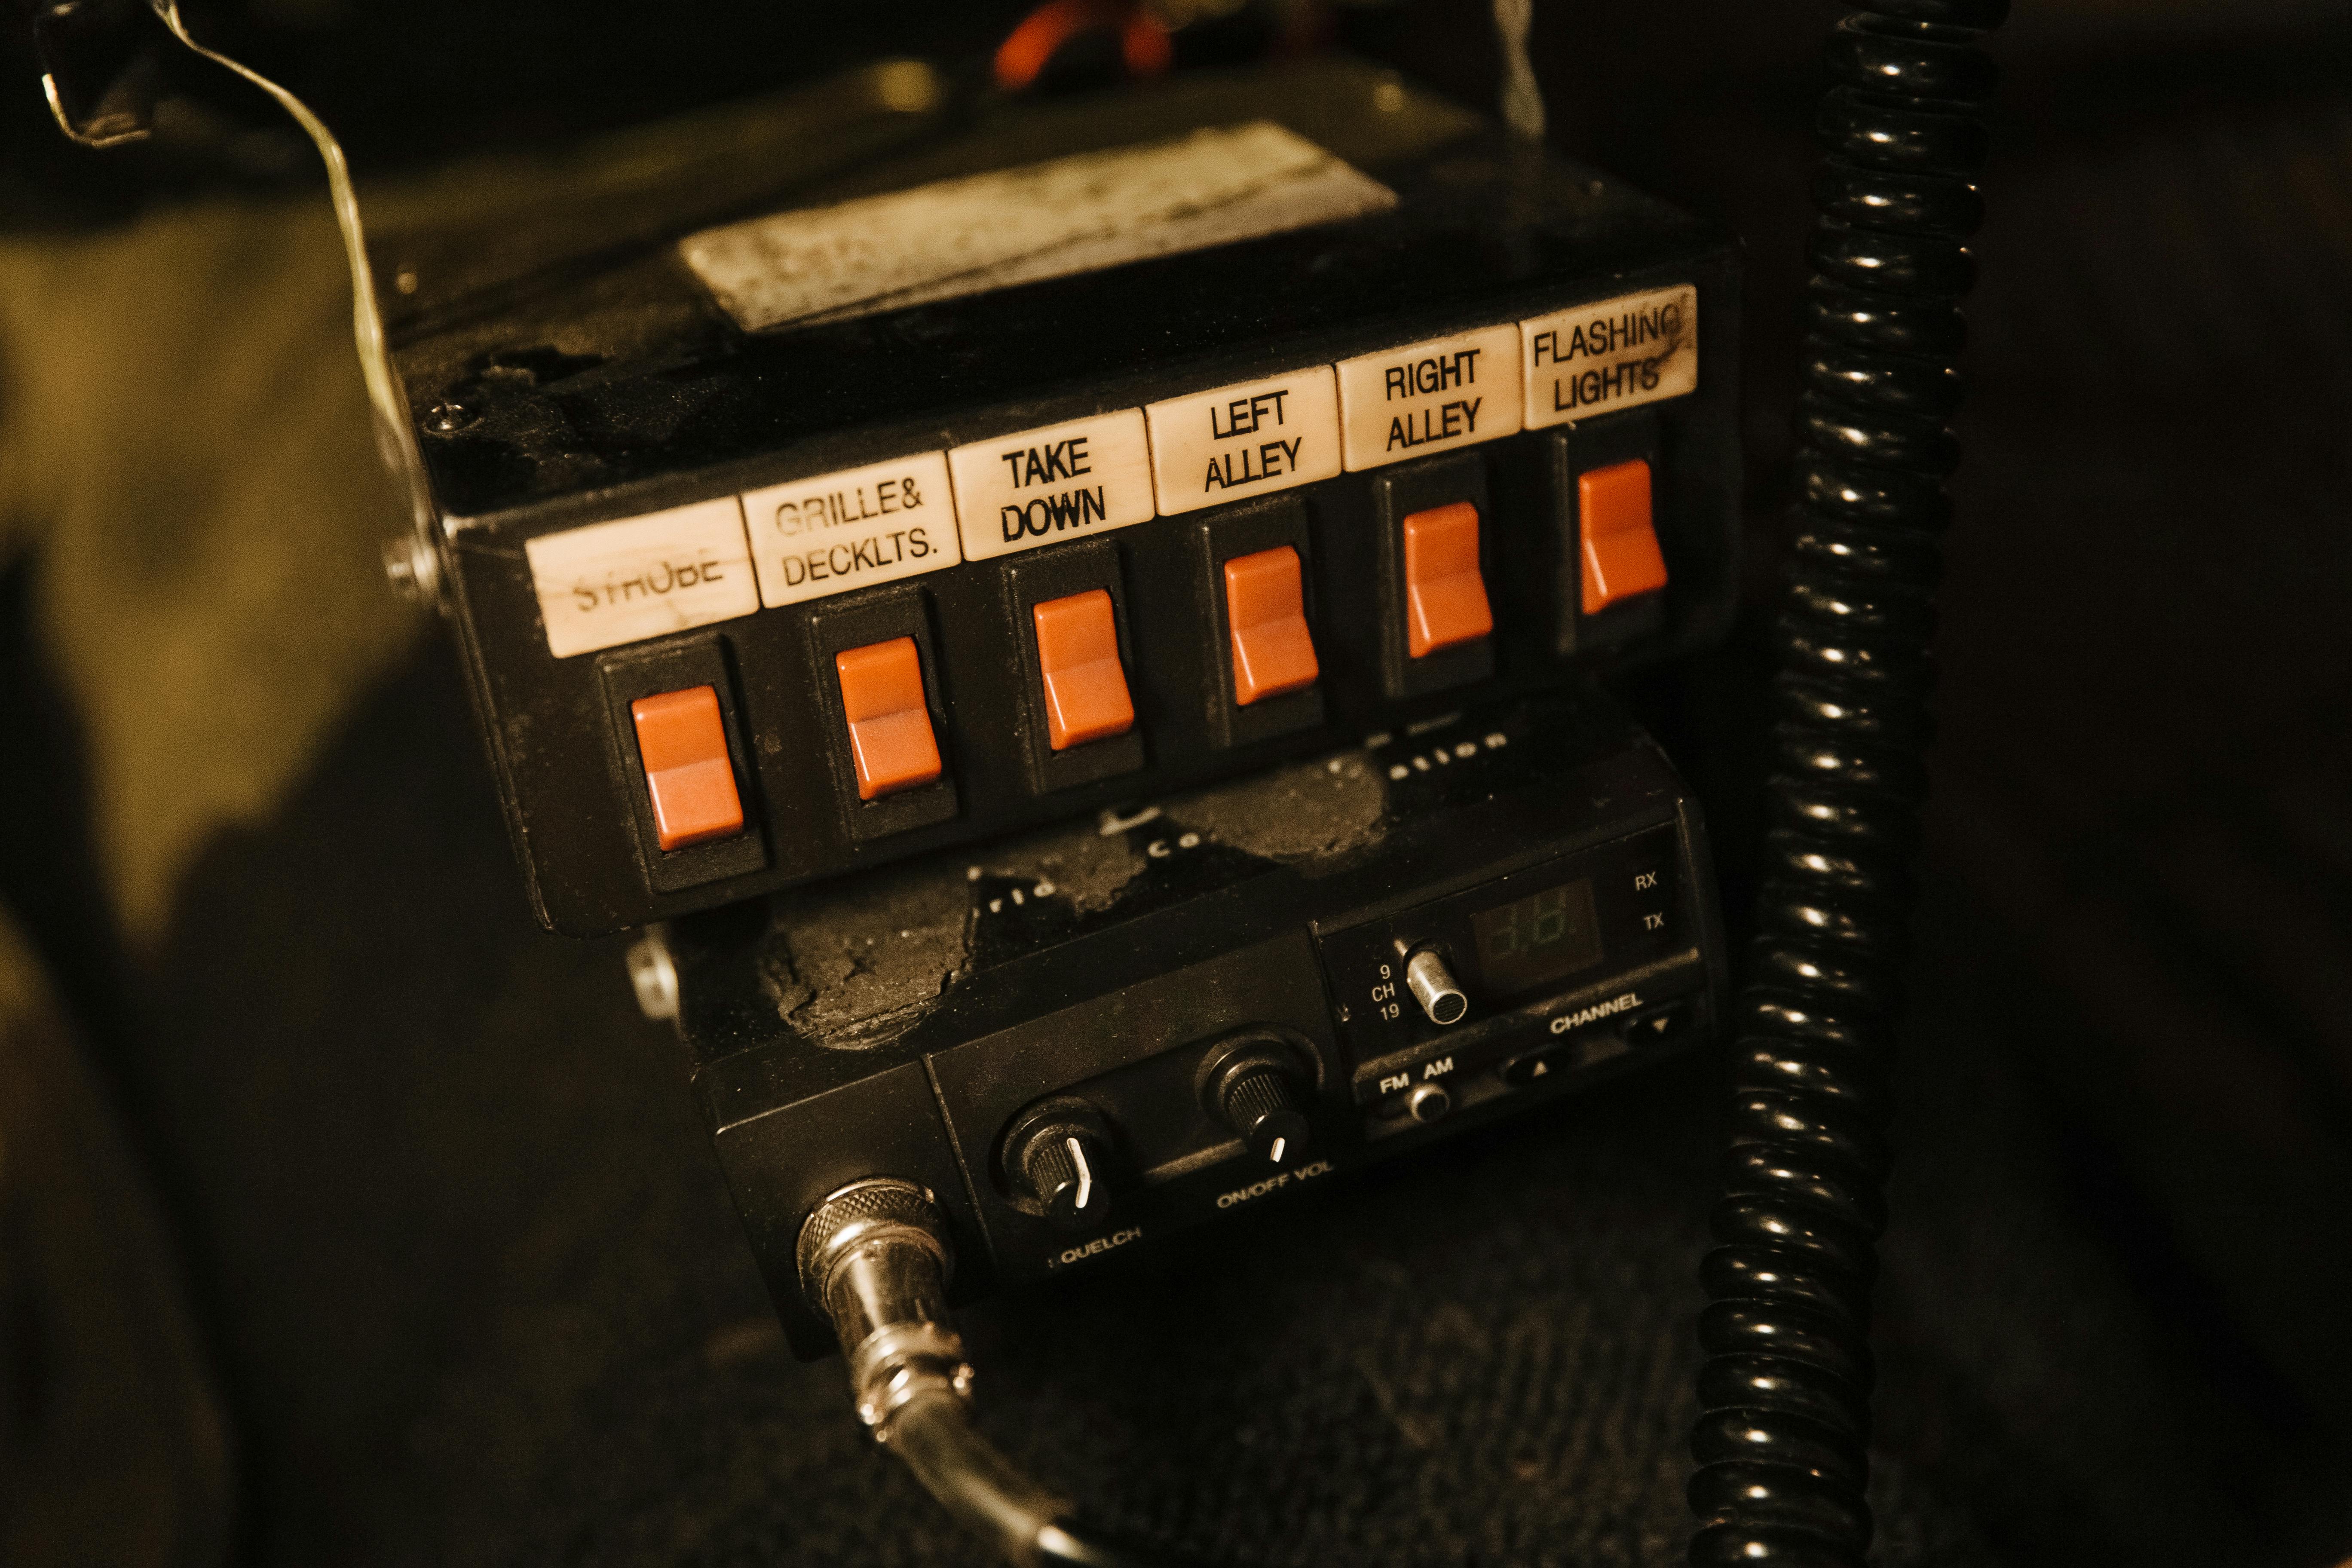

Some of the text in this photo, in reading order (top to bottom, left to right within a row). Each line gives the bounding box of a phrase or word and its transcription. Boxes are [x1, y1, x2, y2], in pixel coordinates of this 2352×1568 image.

[1385, 349, 1480, 401] RIGHT
[1555, 357, 1660, 411] LIGHTS
[1211, 389, 1288, 440] LEFT
[1386, 397, 1482, 451] ALLEY
[1002, 437, 1091, 488] TAKE
[1204, 437, 1302, 492] ALLEY
[776, 477, 923, 536] GRILLE&
[1001, 486, 1106, 542] DOWN
[782, 528, 937, 587] DECKLTS.
[1635, 871, 1657, 891] RX
[1643, 912, 1664, 931] TX
[1372, 983, 1395, 1001] CH
[1380, 965, 1390, 979] 9
[1380, 1003, 1400, 1020] 19
[1550, 992, 1644, 1034] CHANNEL
[1379, 1056, 1454, 1094] FM AM
[1216, 1160, 1333, 1208] ON/OFF VOL
[1047, 1227, 1142, 1268] QUELCH
